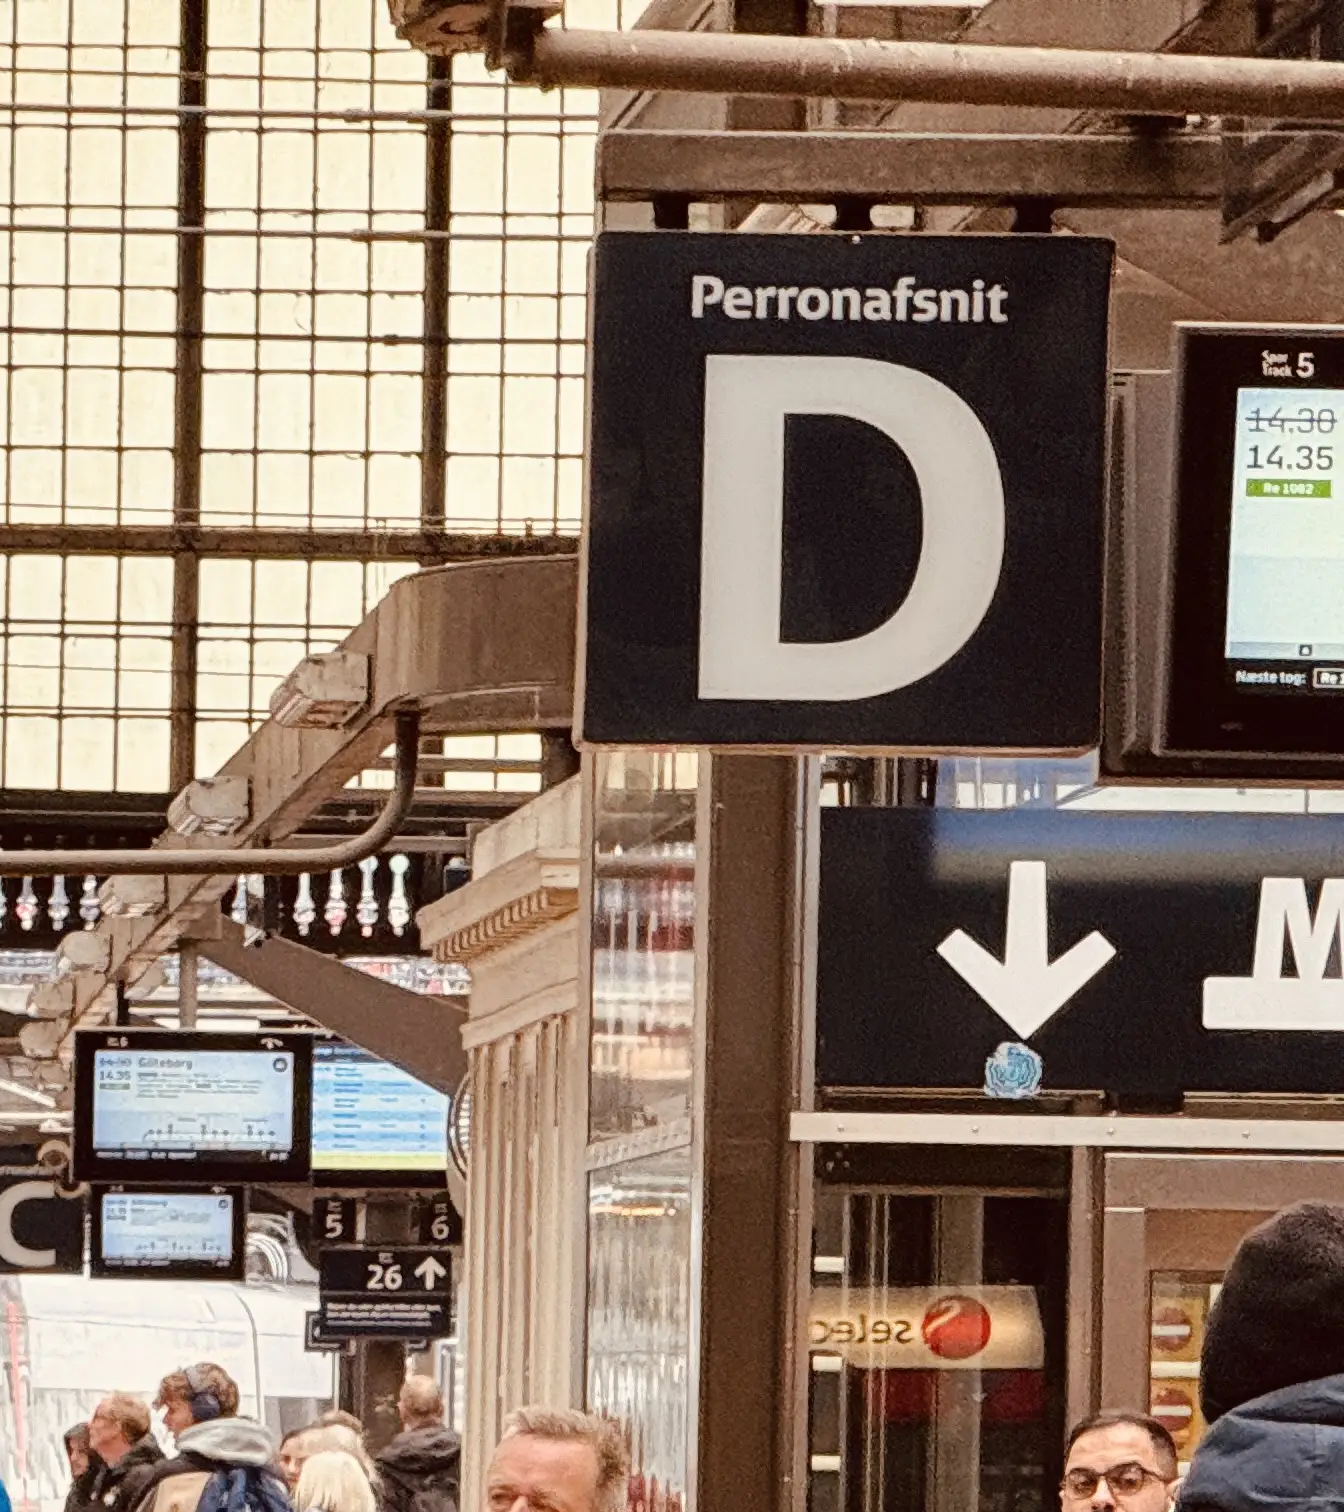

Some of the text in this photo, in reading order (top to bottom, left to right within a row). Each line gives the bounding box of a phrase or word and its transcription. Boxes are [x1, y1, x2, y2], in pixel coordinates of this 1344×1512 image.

[691, 275, 1010, 324] Perronafsnit
[1295, 352, 1315, 378] 5
[1246, 444, 1334, 471] 14.35
[697, 354, 1007, 702] D
[324, 1213, 343, 1239] 5
[431, 1215, 450, 1240] 6
[366, 1263, 403, 1291] 26
